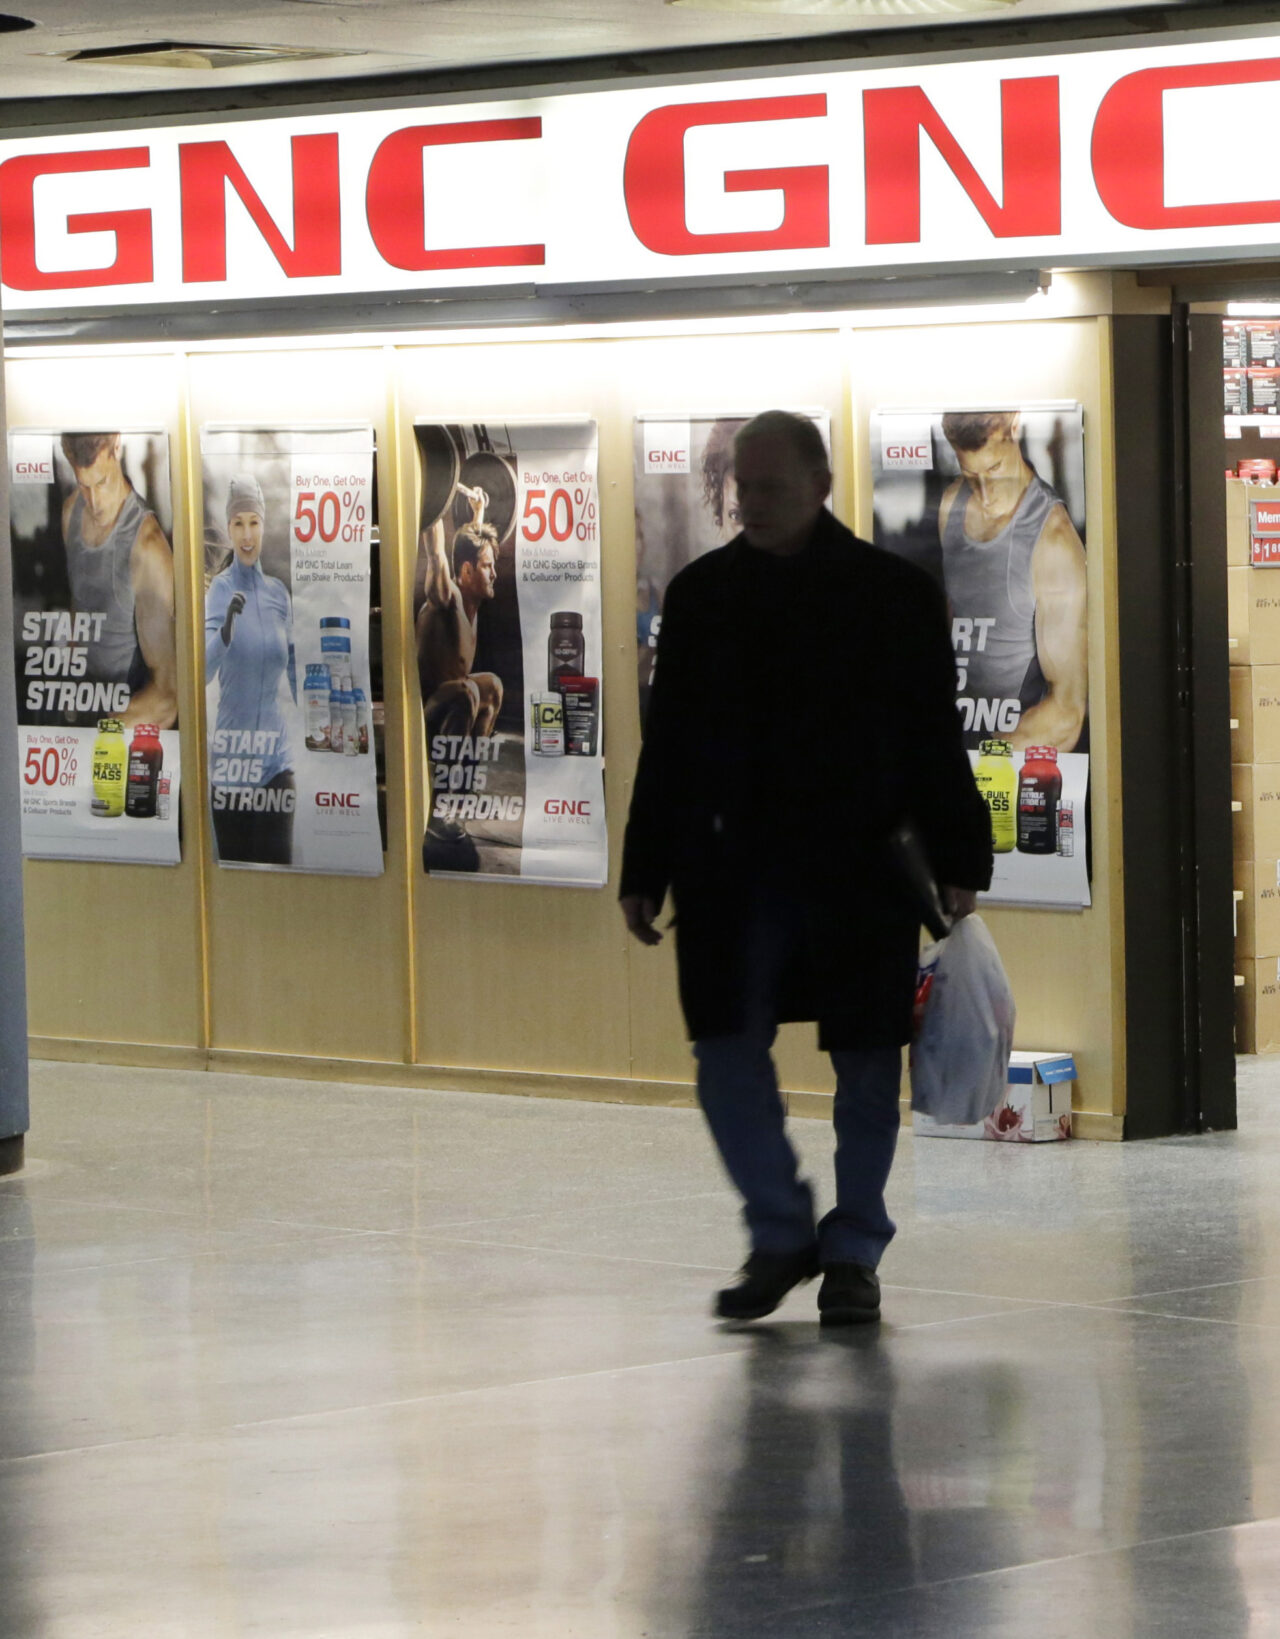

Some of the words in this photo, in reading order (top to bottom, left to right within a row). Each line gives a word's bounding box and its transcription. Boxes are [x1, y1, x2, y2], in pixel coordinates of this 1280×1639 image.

[0, 116, 546, 292] GNC
[648, 450, 686, 463] GNC
[886, 445, 928, 458] GNC
[16, 462, 50, 474] GNC
[296, 476, 310, 488] Buy
[313, 476, 331, 487] One,
[333, 476, 348, 486] Get
[350, 475, 366, 486] One
[524, 472, 540, 485] Buy
[543, 472, 561, 485] One,
[562, 472, 577, 483] Get
[579, 472, 593, 482] One
[294, 490, 365, 543] 50%
[521, 487, 596, 542] 50%
[341, 524, 366, 543] Off
[575, 522, 596, 541] Off
[321, 561, 336, 569] Total
[532, 560, 550, 569] GNC
[551, 560, 576, 570] Sports
[333, 573, 364, 583] Products
[522, 573, 529, 581] &
[530, 573, 562, 581] Cellucor
[22, 611, 107, 642] START
[24, 646, 89, 677] 2015
[26, 681, 131, 713] STRONG
[542, 707, 563, 724] C4
[26, 734, 38, 744] Buy
[55, 736, 66, 744] Get
[66, 736, 79, 745] One
[213, 729, 280, 754] START
[431, 735, 505, 762] START
[24, 747, 77, 786] 50%
[213, 757, 263, 783] 2015
[60, 772, 77, 786] Off
[93, 770, 122, 781] MASS
[433, 764, 487, 791] 2015
[213, 786, 297, 813] STRONG
[315, 792, 361, 808] GNC
[433, 793, 523, 822] STRONG
[544, 799, 591, 816] GNC
[316, 808, 336, 816] LIVE
[543, 815, 563, 823] LIVE
[567, 815, 592, 825] WELL
